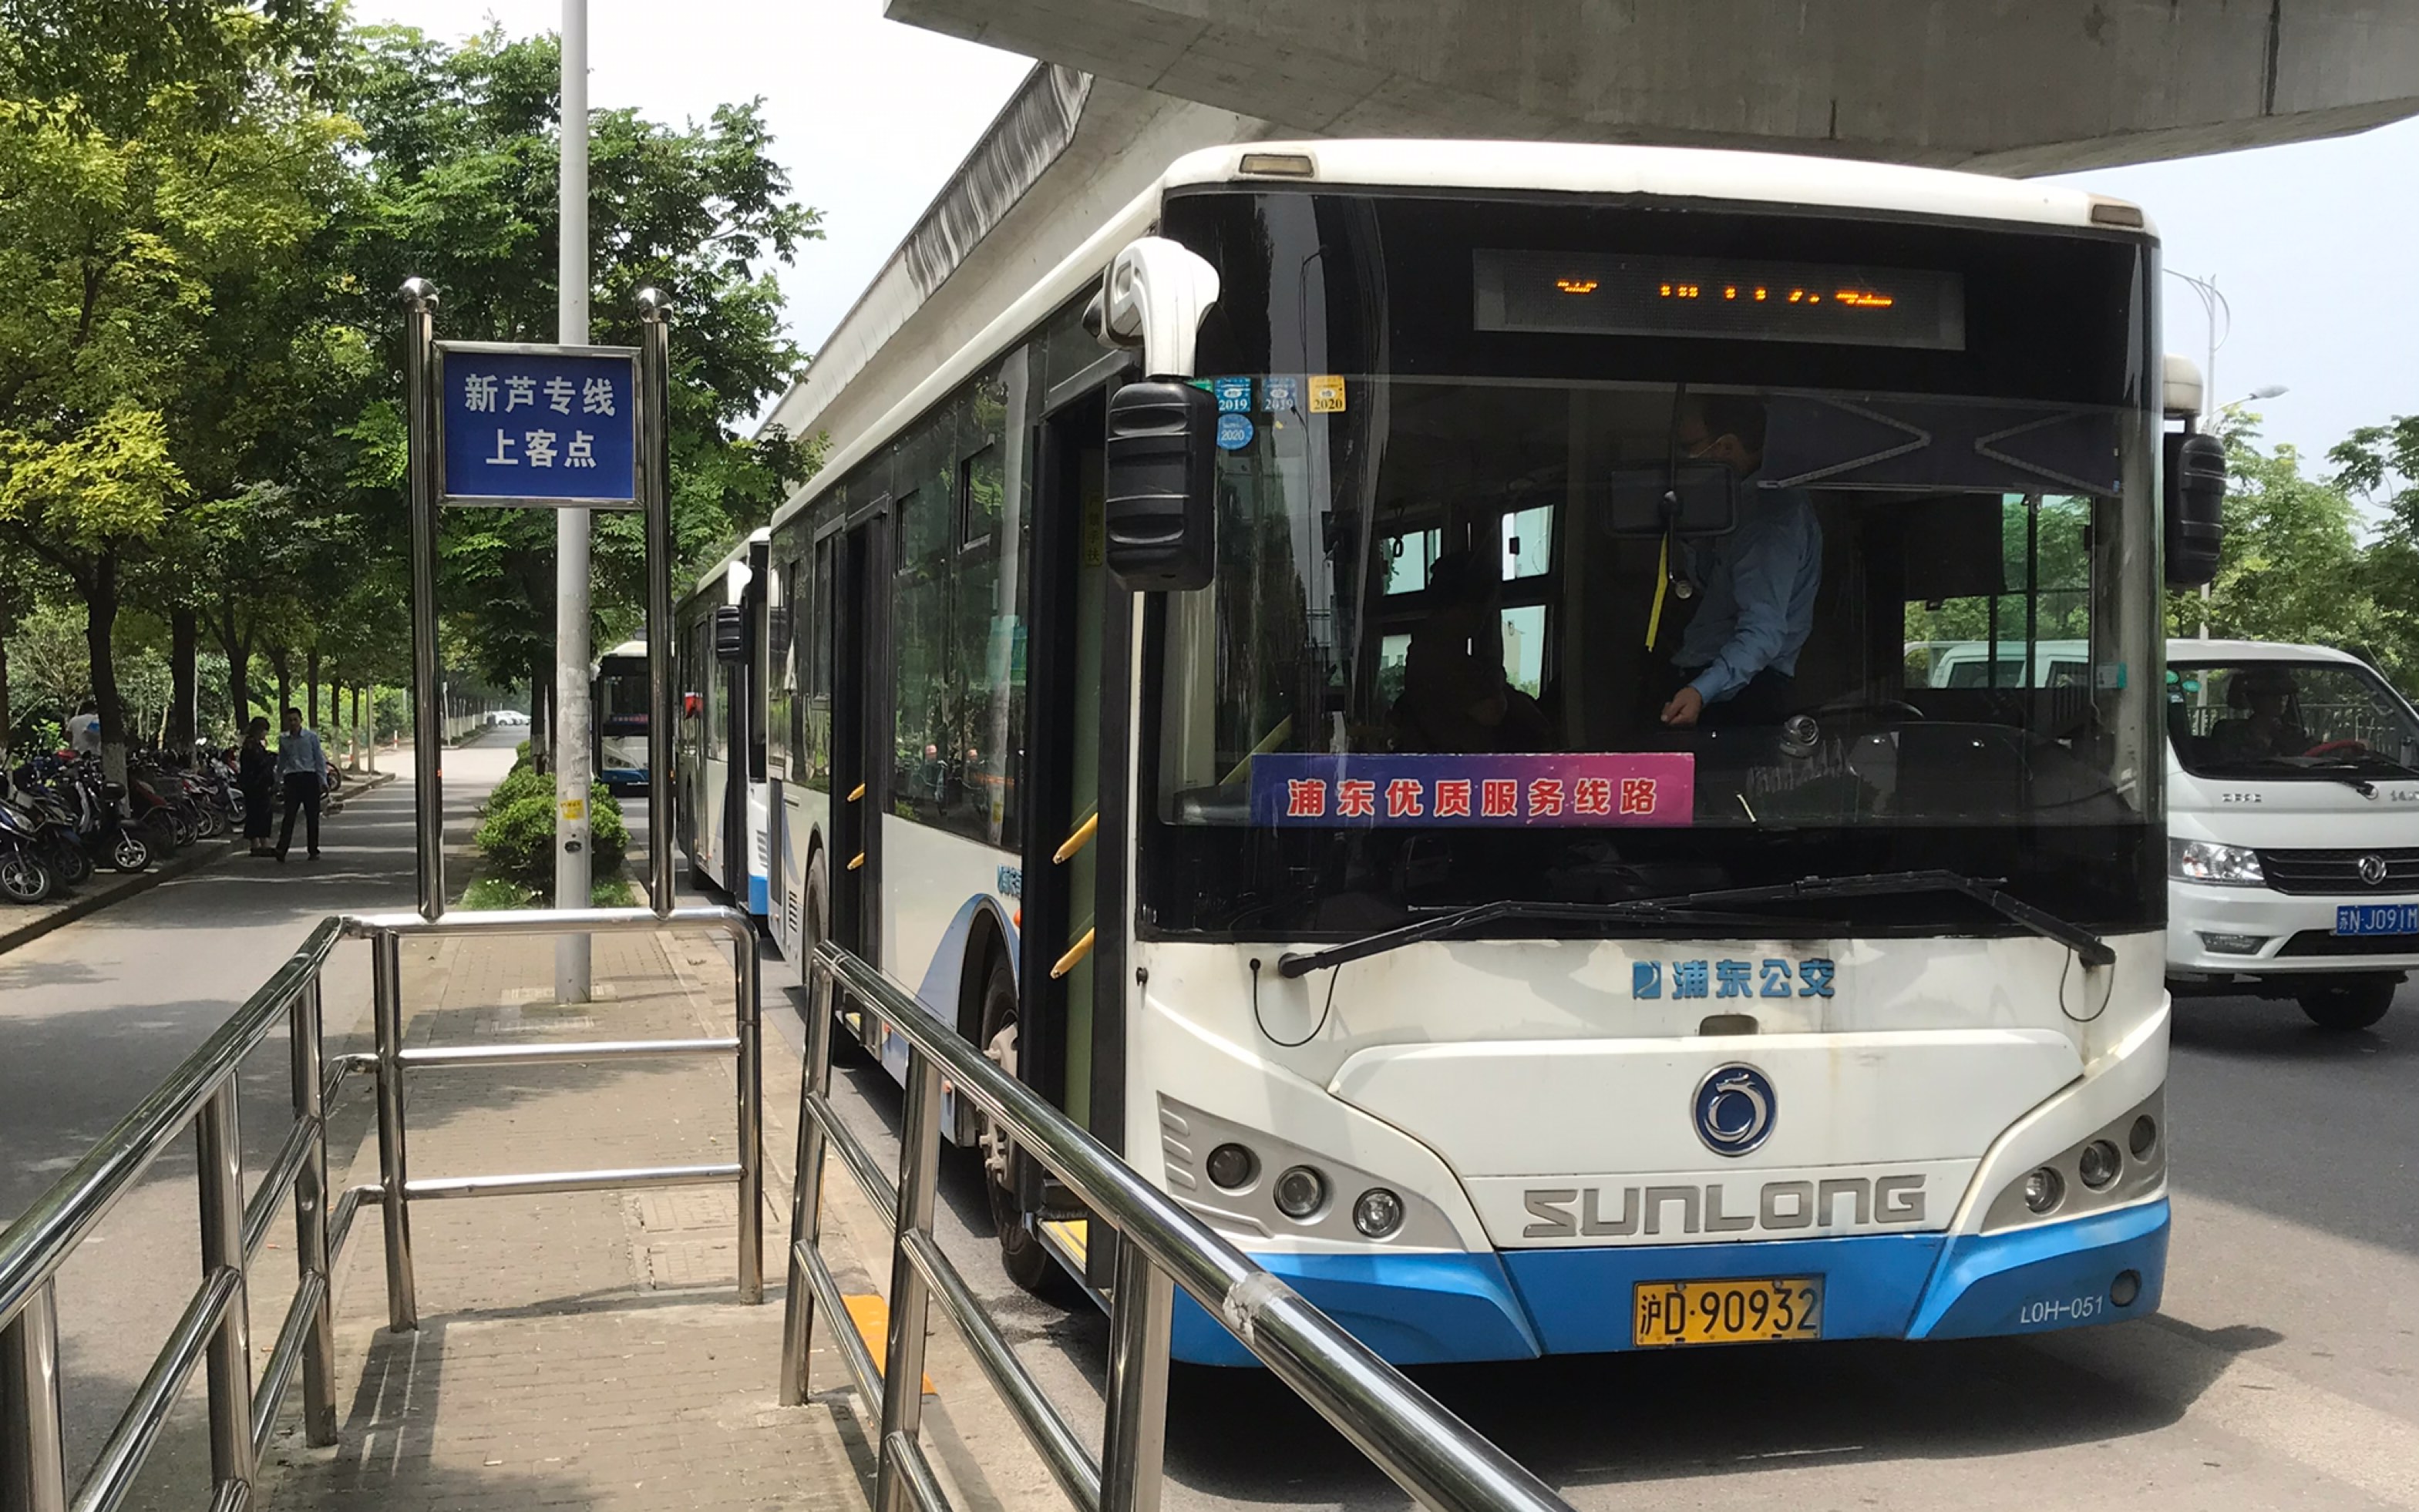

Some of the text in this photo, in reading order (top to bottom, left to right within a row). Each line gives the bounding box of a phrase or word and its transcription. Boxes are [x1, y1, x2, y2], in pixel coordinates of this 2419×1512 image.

[465, 374, 615, 416] 新芦专线
[1219, 399, 1247, 411] 2019
[1265, 398, 1293, 410] 2019
[1314, 399, 1343, 410] 2020
[486, 429, 596, 468] 上客点
[1220, 431, 1245, 441] 2020
[1286, 777, 1659, 818] 浦东优质服务线路
[1671, 959, 1836, 1000] 浦东公交
[1522, 1174, 1926, 1237] SUNLONG
